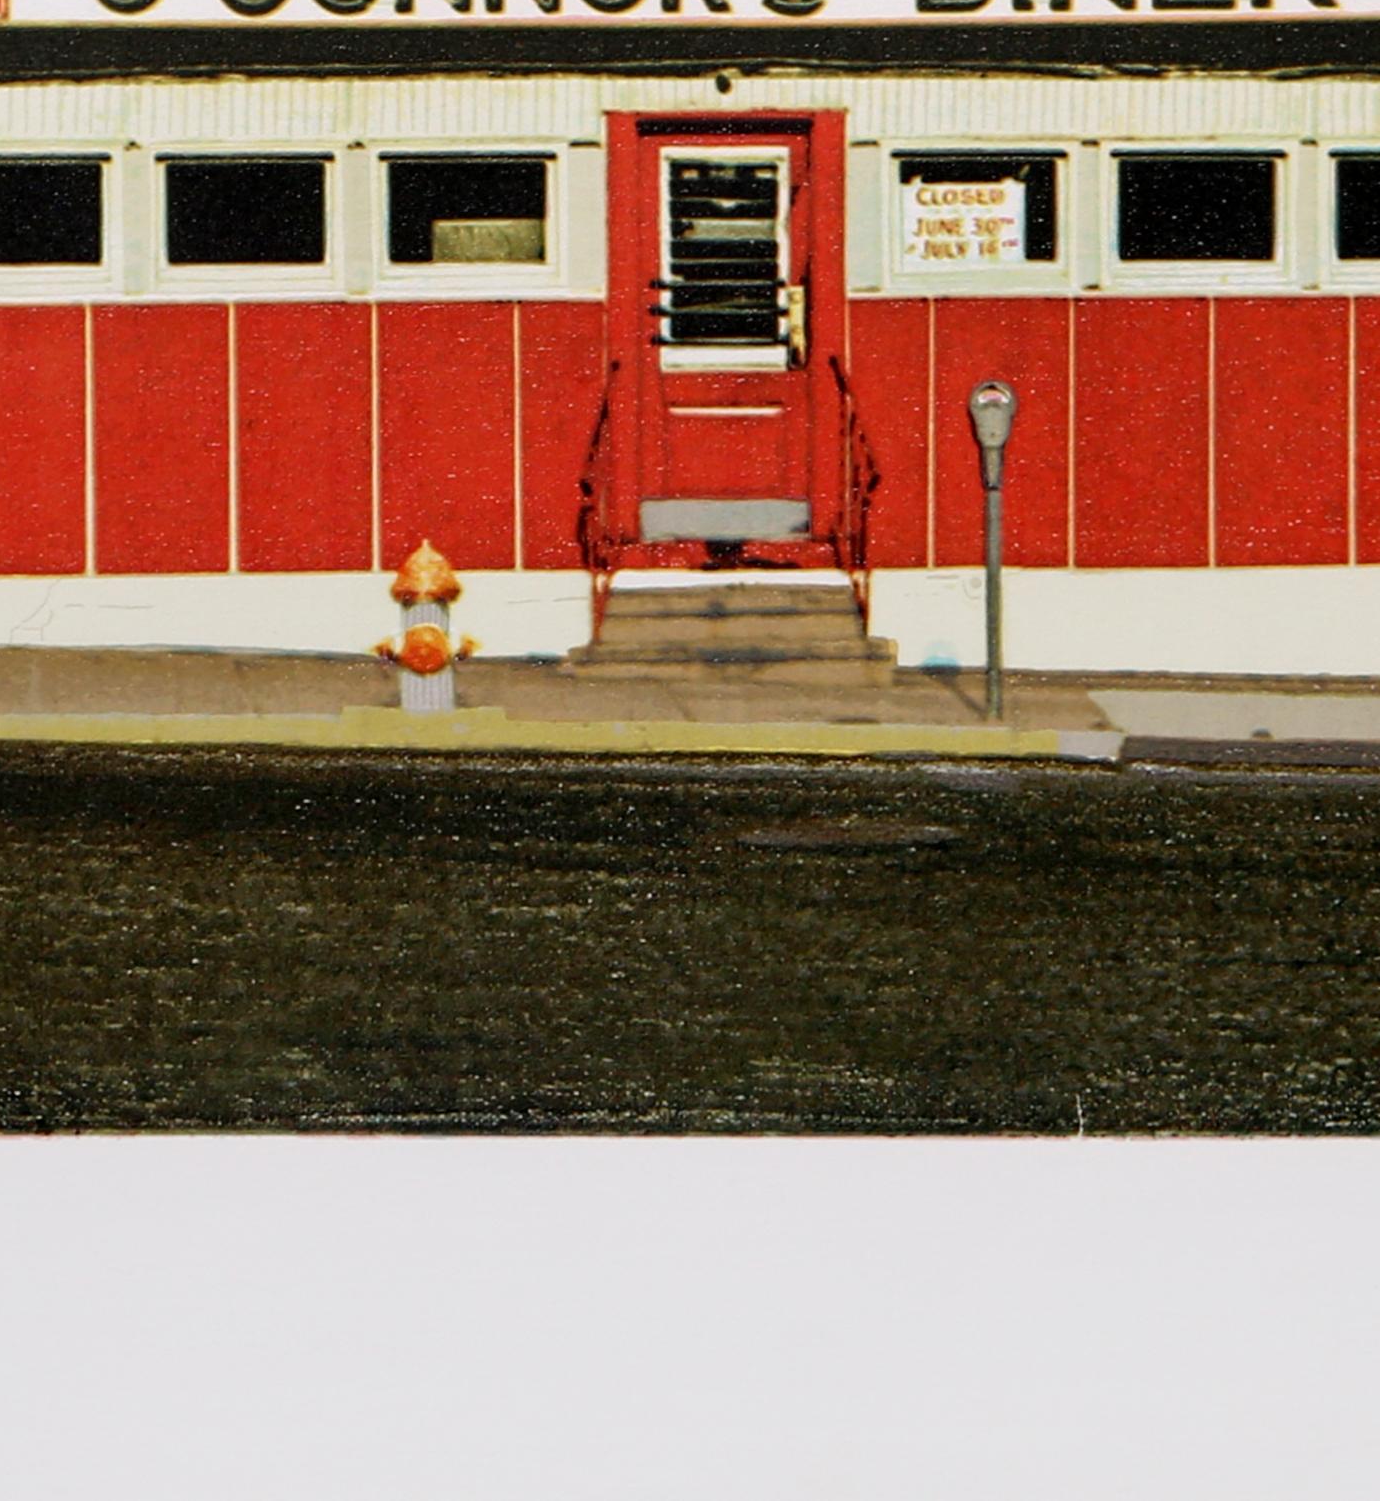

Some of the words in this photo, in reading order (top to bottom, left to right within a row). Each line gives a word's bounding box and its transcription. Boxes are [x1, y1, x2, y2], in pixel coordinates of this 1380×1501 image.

[915, 186, 1007, 206] CLOSED
[912, 216, 965, 238] JUNE
[921, 239, 969, 261] JULY
